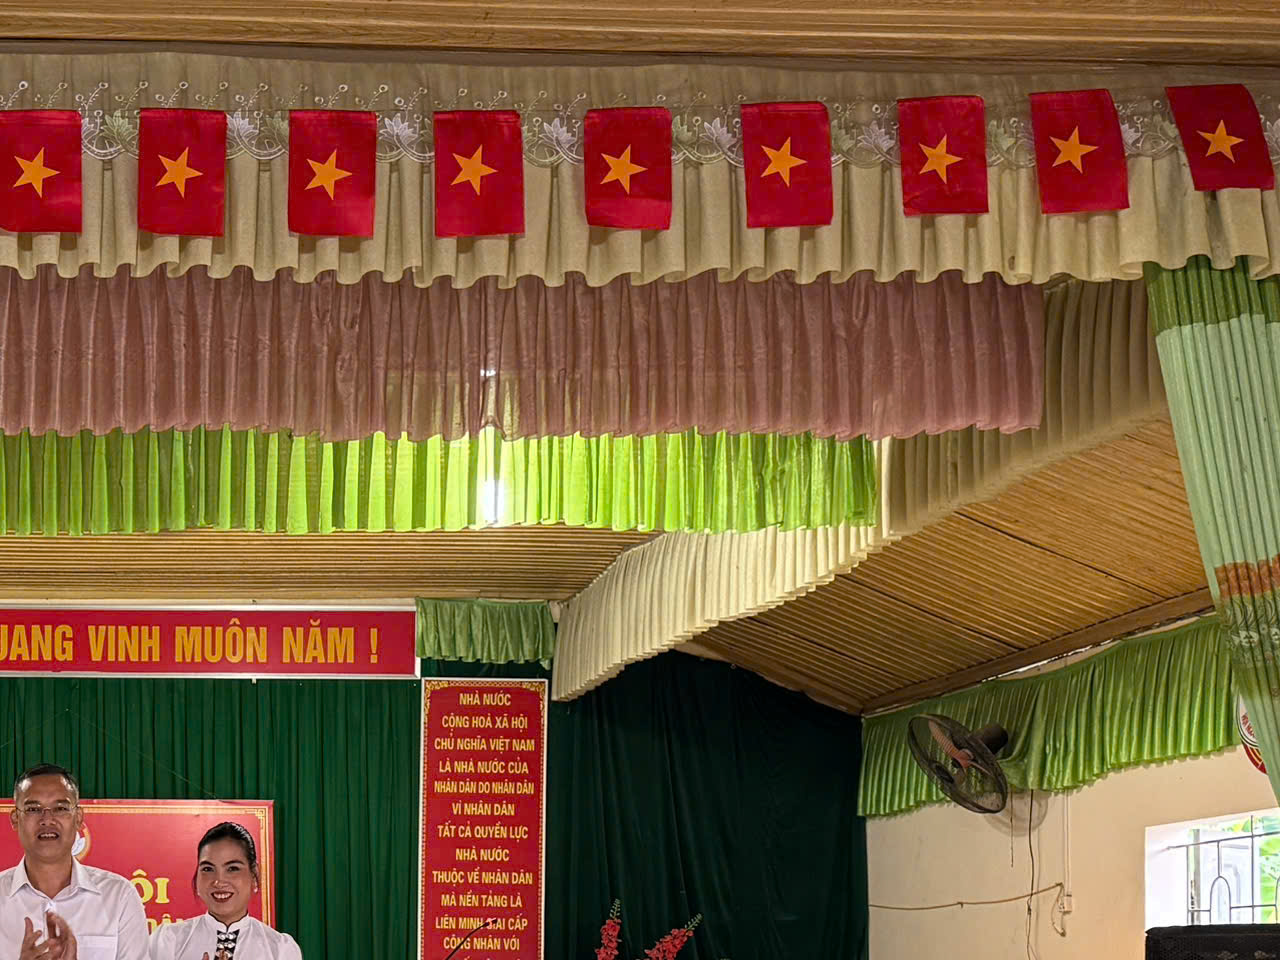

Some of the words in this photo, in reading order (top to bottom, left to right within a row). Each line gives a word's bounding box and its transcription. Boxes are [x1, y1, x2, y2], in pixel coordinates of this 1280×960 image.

[88, 626, 160, 662] VINH
[175, 618, 268, 664] MUÔN
[282, 619, 354, 664] NĂM
[459, 690, 481, 705] NHÀ
[483, 690, 512, 706] NƯỚC
[441, 712, 470, 732] CỘNG
[495, 713, 509, 729] XÃ
[511, 713, 528, 733] HỘI
[434, 732, 454, 750] CHỦ
[456, 735, 487, 750] NGHĨA
[489, 735, 511, 754] VIỆT
[512, 738, 535, 751] NAM
[439, 757, 452, 773] LÀ
[454, 757, 475, 773] NHÀ
[477, 758, 506, 774] NƯỚC
[508, 756, 529, 774] CỦA
[434, 777, 457, 793] NHÂN
[459, 777, 477, 794] DÂN
[478, 781, 490, 794] DO
[492, 778, 515, 794] NHÂN
[516, 779, 534, 794] DÂN
[463, 800, 491, 815] NHÂN
[493, 800, 515, 816] DÂN
[437, 820, 456, 838] TẤT
[458, 820, 472, 838] CẢ
[509, 825, 529, 843] LỰC
[455, 845, 478, 861] NHÀ
[480, 845, 510, 861] NƯỚC
[432, 867, 465, 887] THUỘC
[481, 868, 509, 884] NHÂN
[511, 869, 533, 885] DÂN
[441, 891, 457, 906] MÀ
[481, 889, 508, 908] TẢNG
[510, 892, 523, 908] LÀ
[435, 914, 456, 929] LIÊN
[458, 917, 484, 930] MINH
[508, 913, 528, 931] CẤP
[473, 935, 500, 950] NHÂN
[503, 935, 520, 951] VỚI
